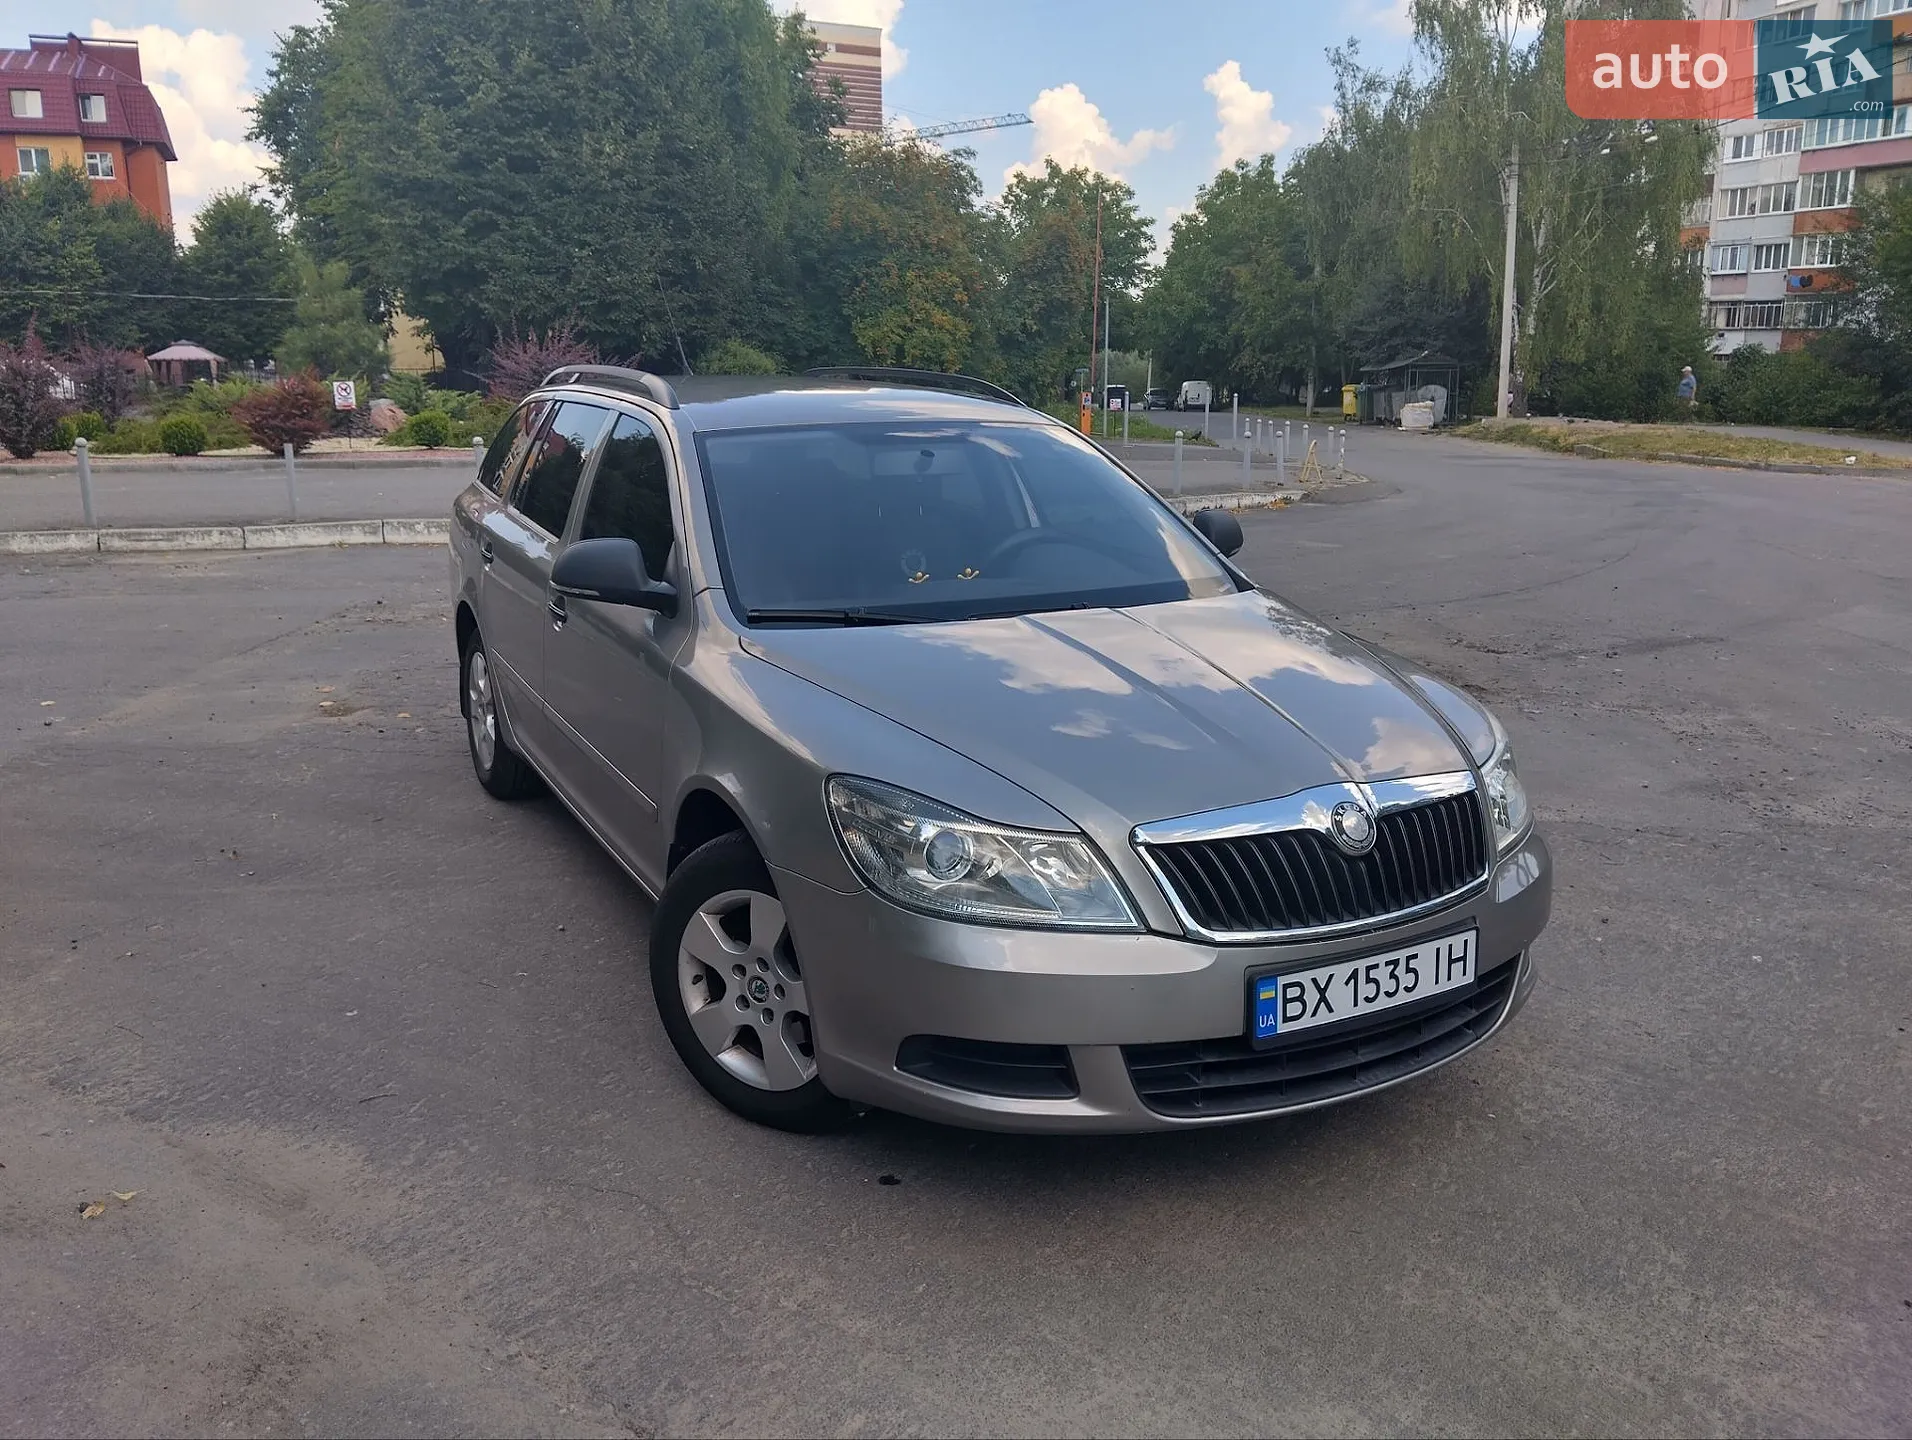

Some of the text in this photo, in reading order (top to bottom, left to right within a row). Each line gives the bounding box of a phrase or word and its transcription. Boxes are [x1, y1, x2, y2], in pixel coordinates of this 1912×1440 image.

[1281, 938, 1469, 1024] BX 1535 IH
[1259, 1013, 1275, 1028] UA
